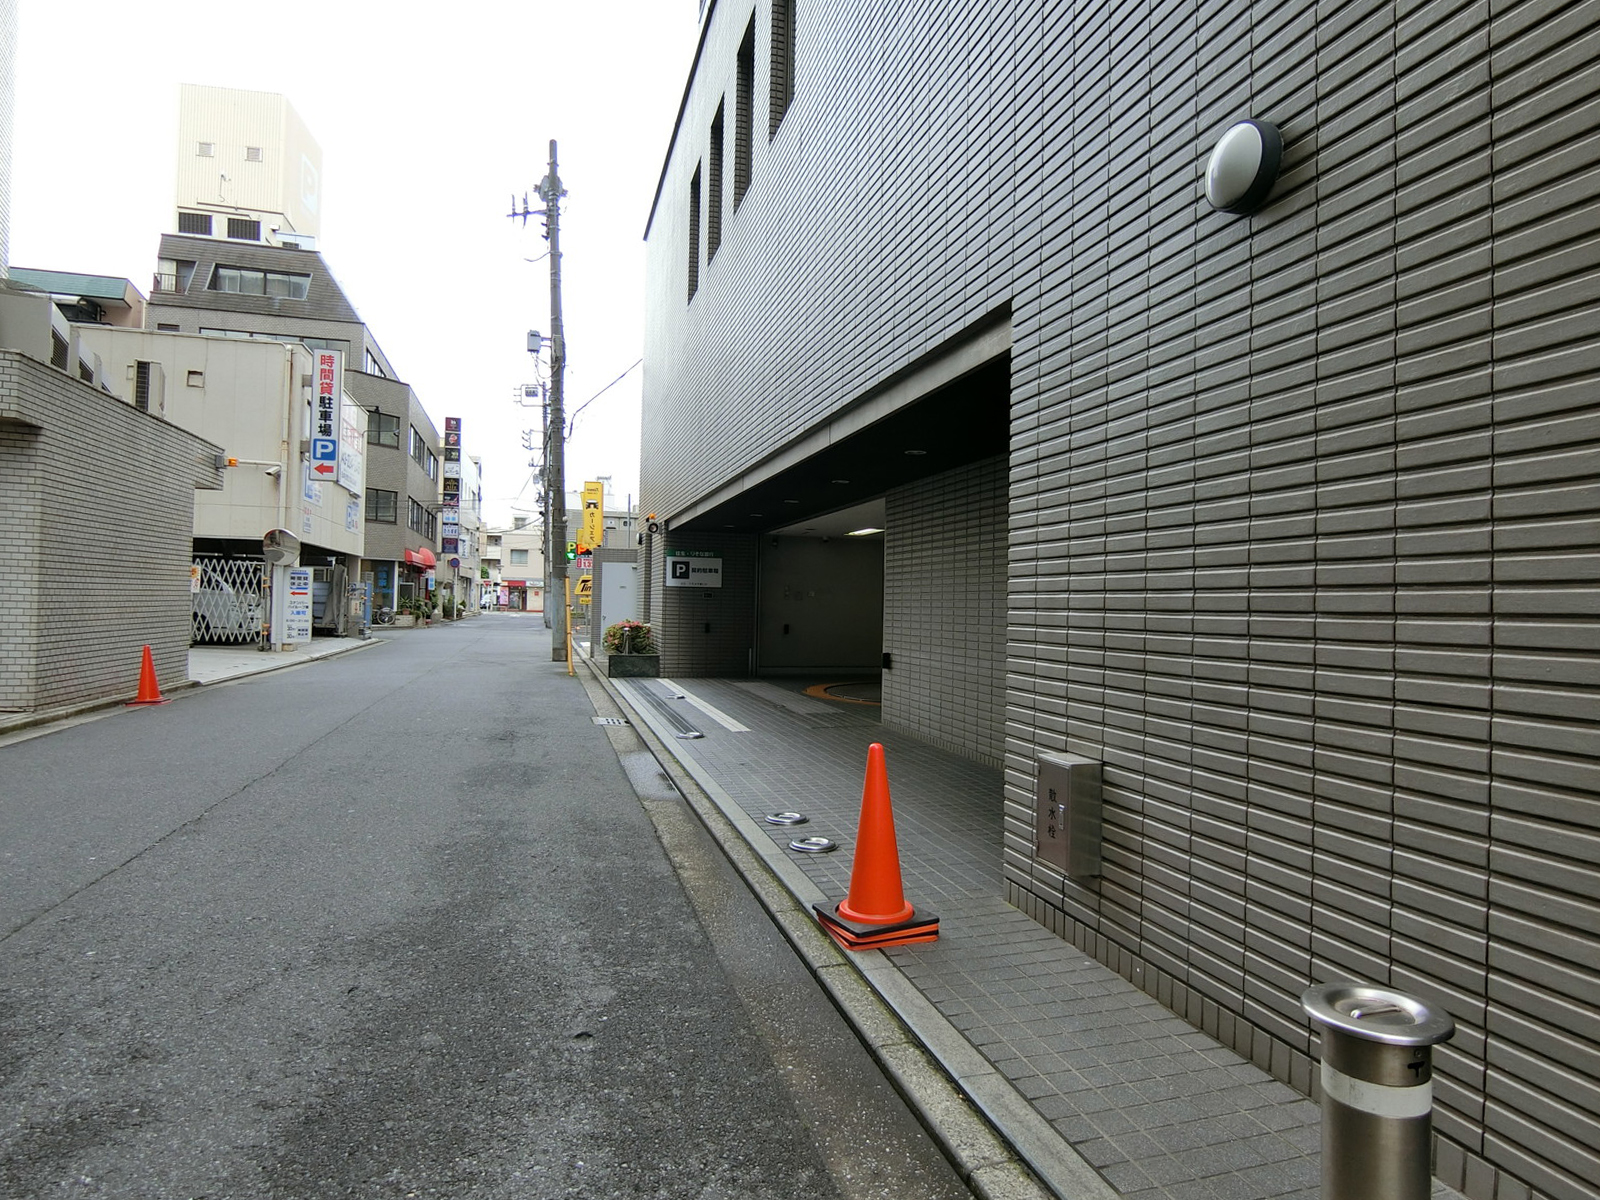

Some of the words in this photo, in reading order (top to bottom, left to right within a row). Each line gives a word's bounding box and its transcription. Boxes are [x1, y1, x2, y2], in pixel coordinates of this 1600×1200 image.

[318, 354, 335, 437] 時間貸駐車場
[315, 441, 334, 459] P
[676, 564, 686, 577] P
[1047, 788, 1057, 839] 散水栓
